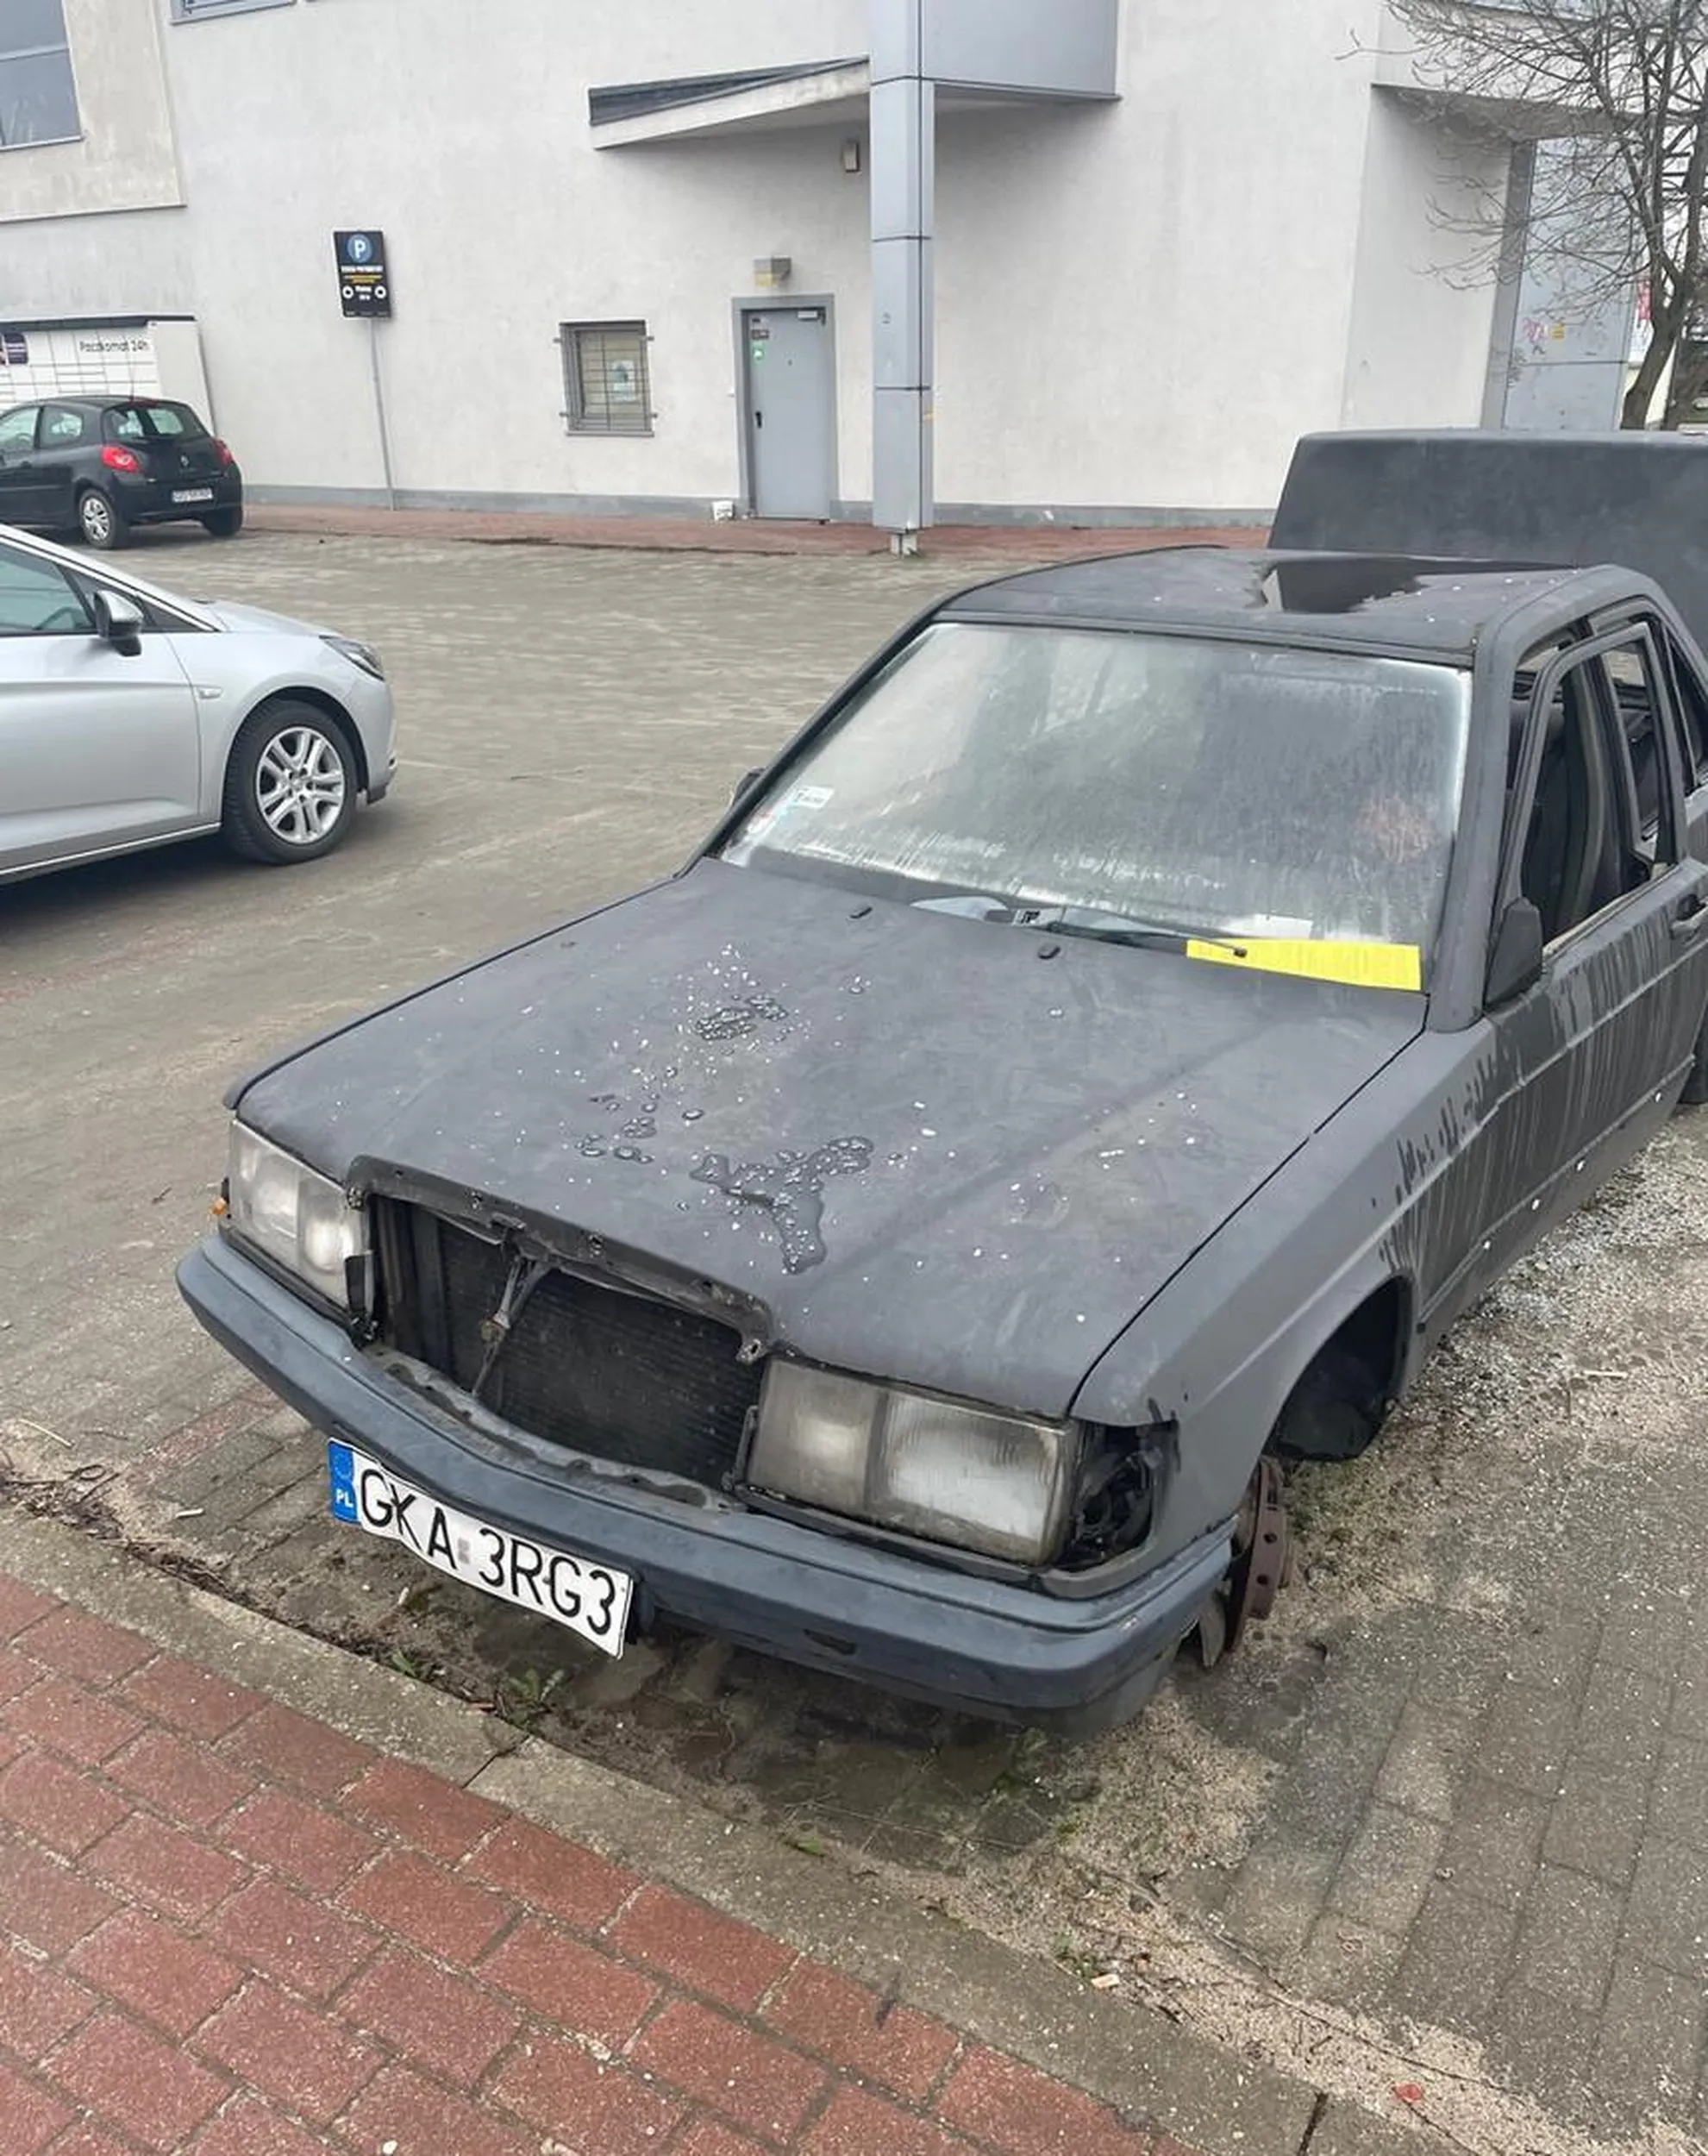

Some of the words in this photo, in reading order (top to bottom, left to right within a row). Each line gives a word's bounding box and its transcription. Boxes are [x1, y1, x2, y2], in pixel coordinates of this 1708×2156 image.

[354, 240, 366, 260] P
[335, 1488, 354, 1508] PL
[360, 1469, 459, 1570] GKA
[479, 1528, 616, 1635] 3RG3
